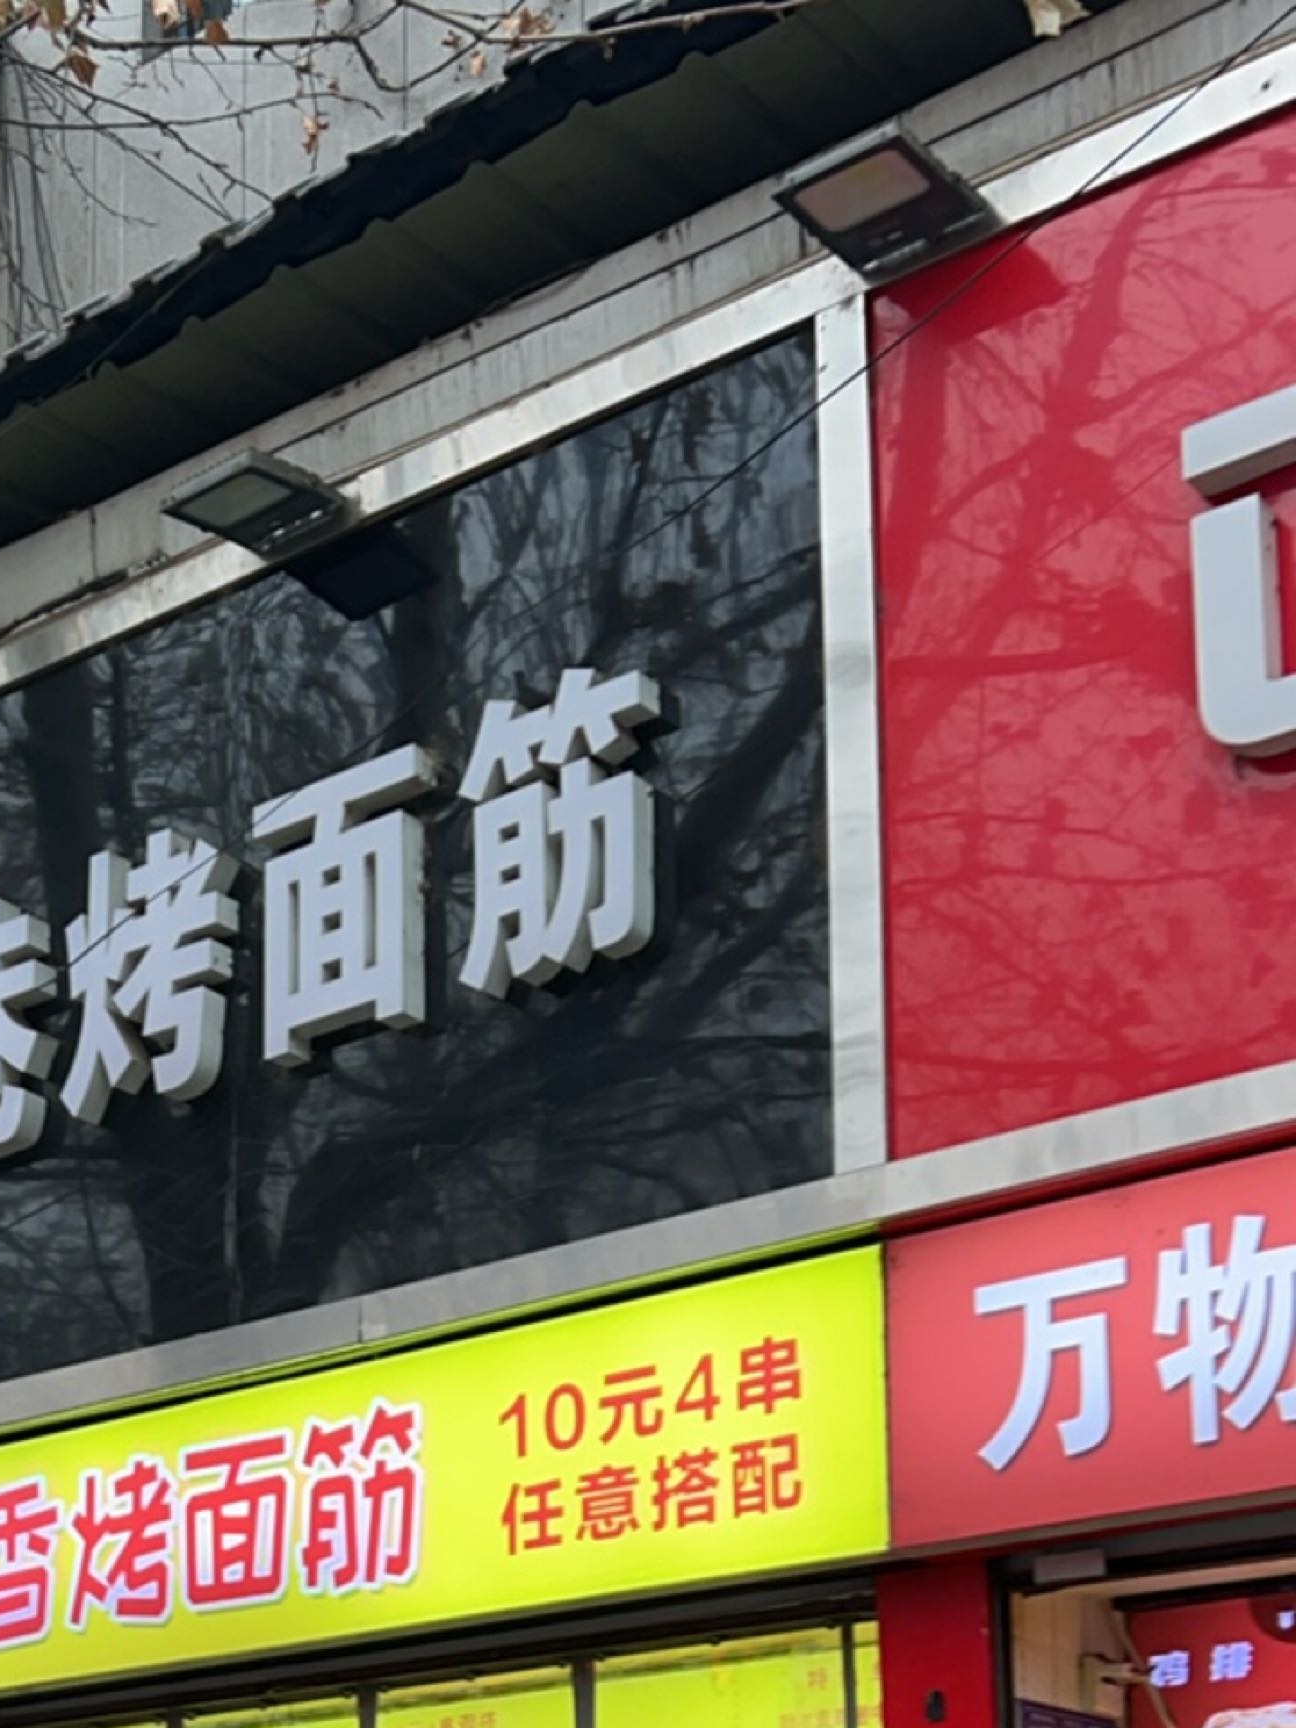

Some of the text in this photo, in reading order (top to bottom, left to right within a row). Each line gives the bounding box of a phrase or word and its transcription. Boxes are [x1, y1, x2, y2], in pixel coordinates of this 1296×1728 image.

[499, 1336, 802, 1458] 10元4串
[974, 1215, 1296, 1471] 万物
[501, 1434, 802, 1554] 任意搭配
